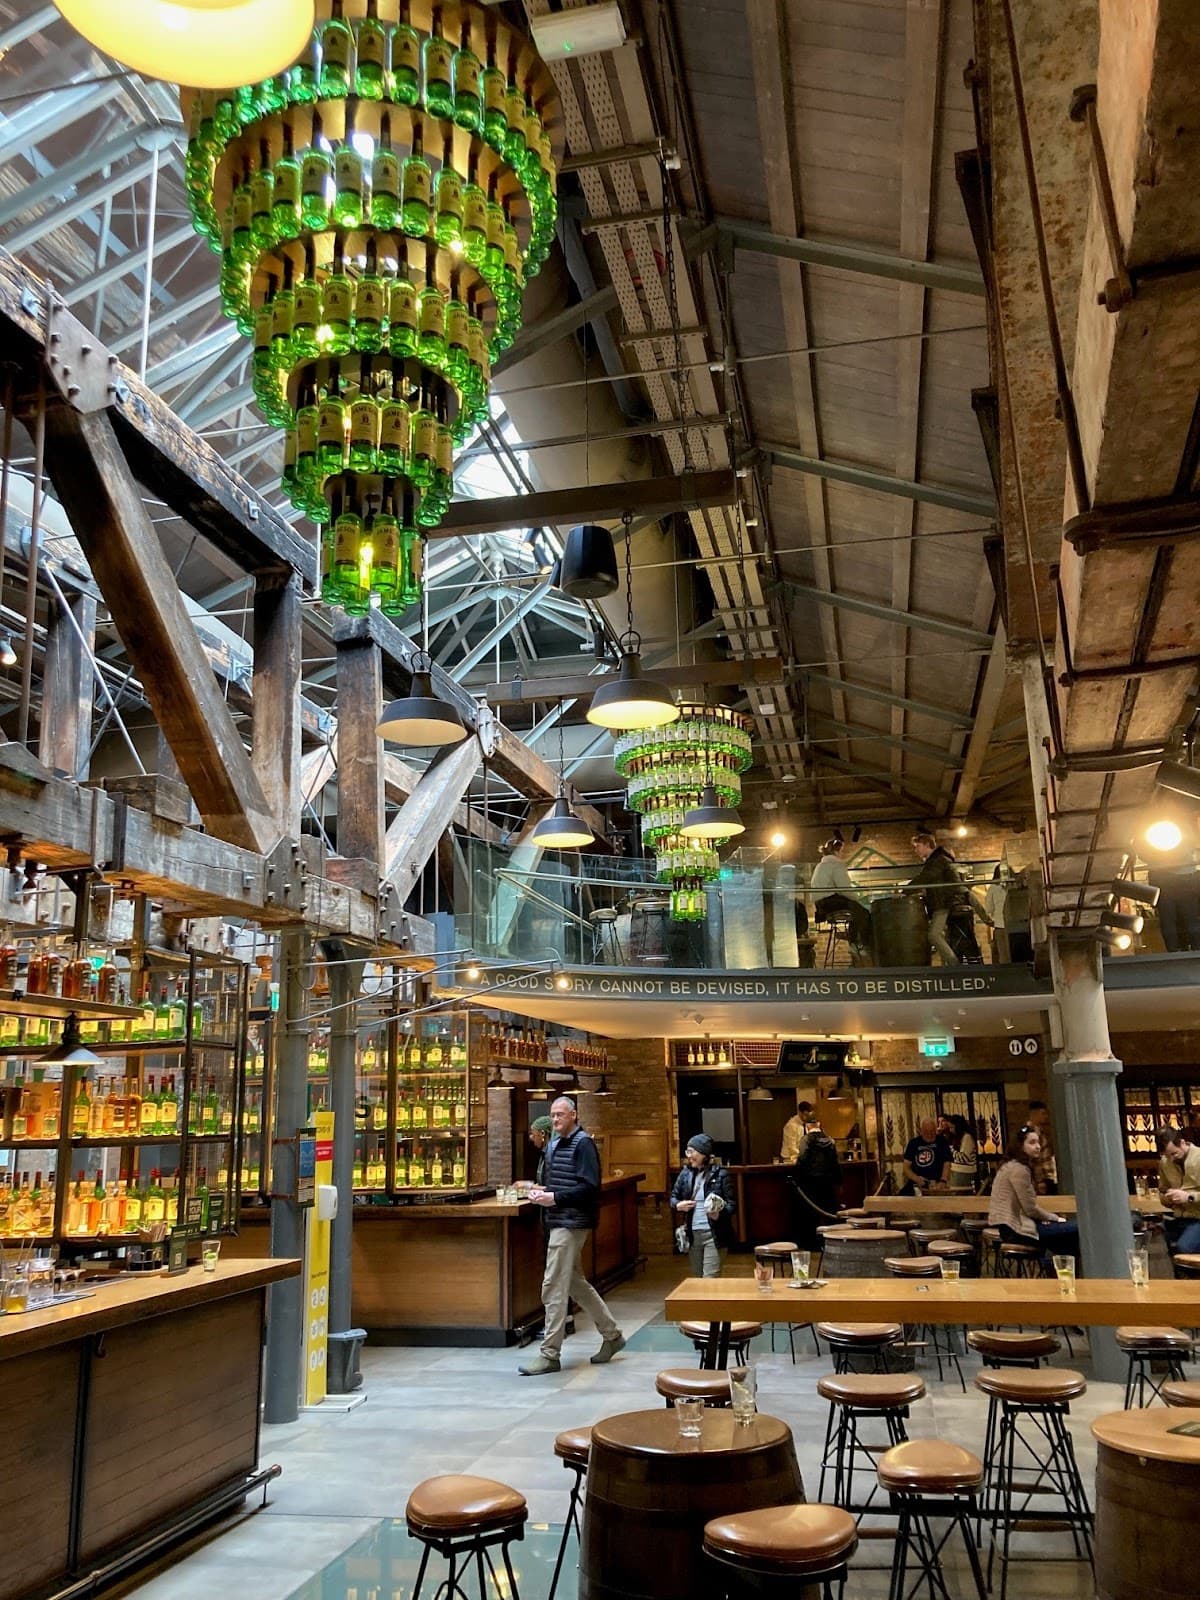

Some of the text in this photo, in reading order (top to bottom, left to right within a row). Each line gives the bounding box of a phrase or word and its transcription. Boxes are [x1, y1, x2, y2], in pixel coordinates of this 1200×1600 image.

[495, 973, 539, 989] GOOD
[544, 976, 594, 991] SORY
[600, 979, 664, 994] CANNOT
[670, 981, 690, 994] BE
[697, 982, 769, 996] DEVISED,
[776, 982, 790, 994] IT
[797, 981, 831, 994] HAS
[837, 981, 858, 994] TO
[865, 980, 888, 993] BE
